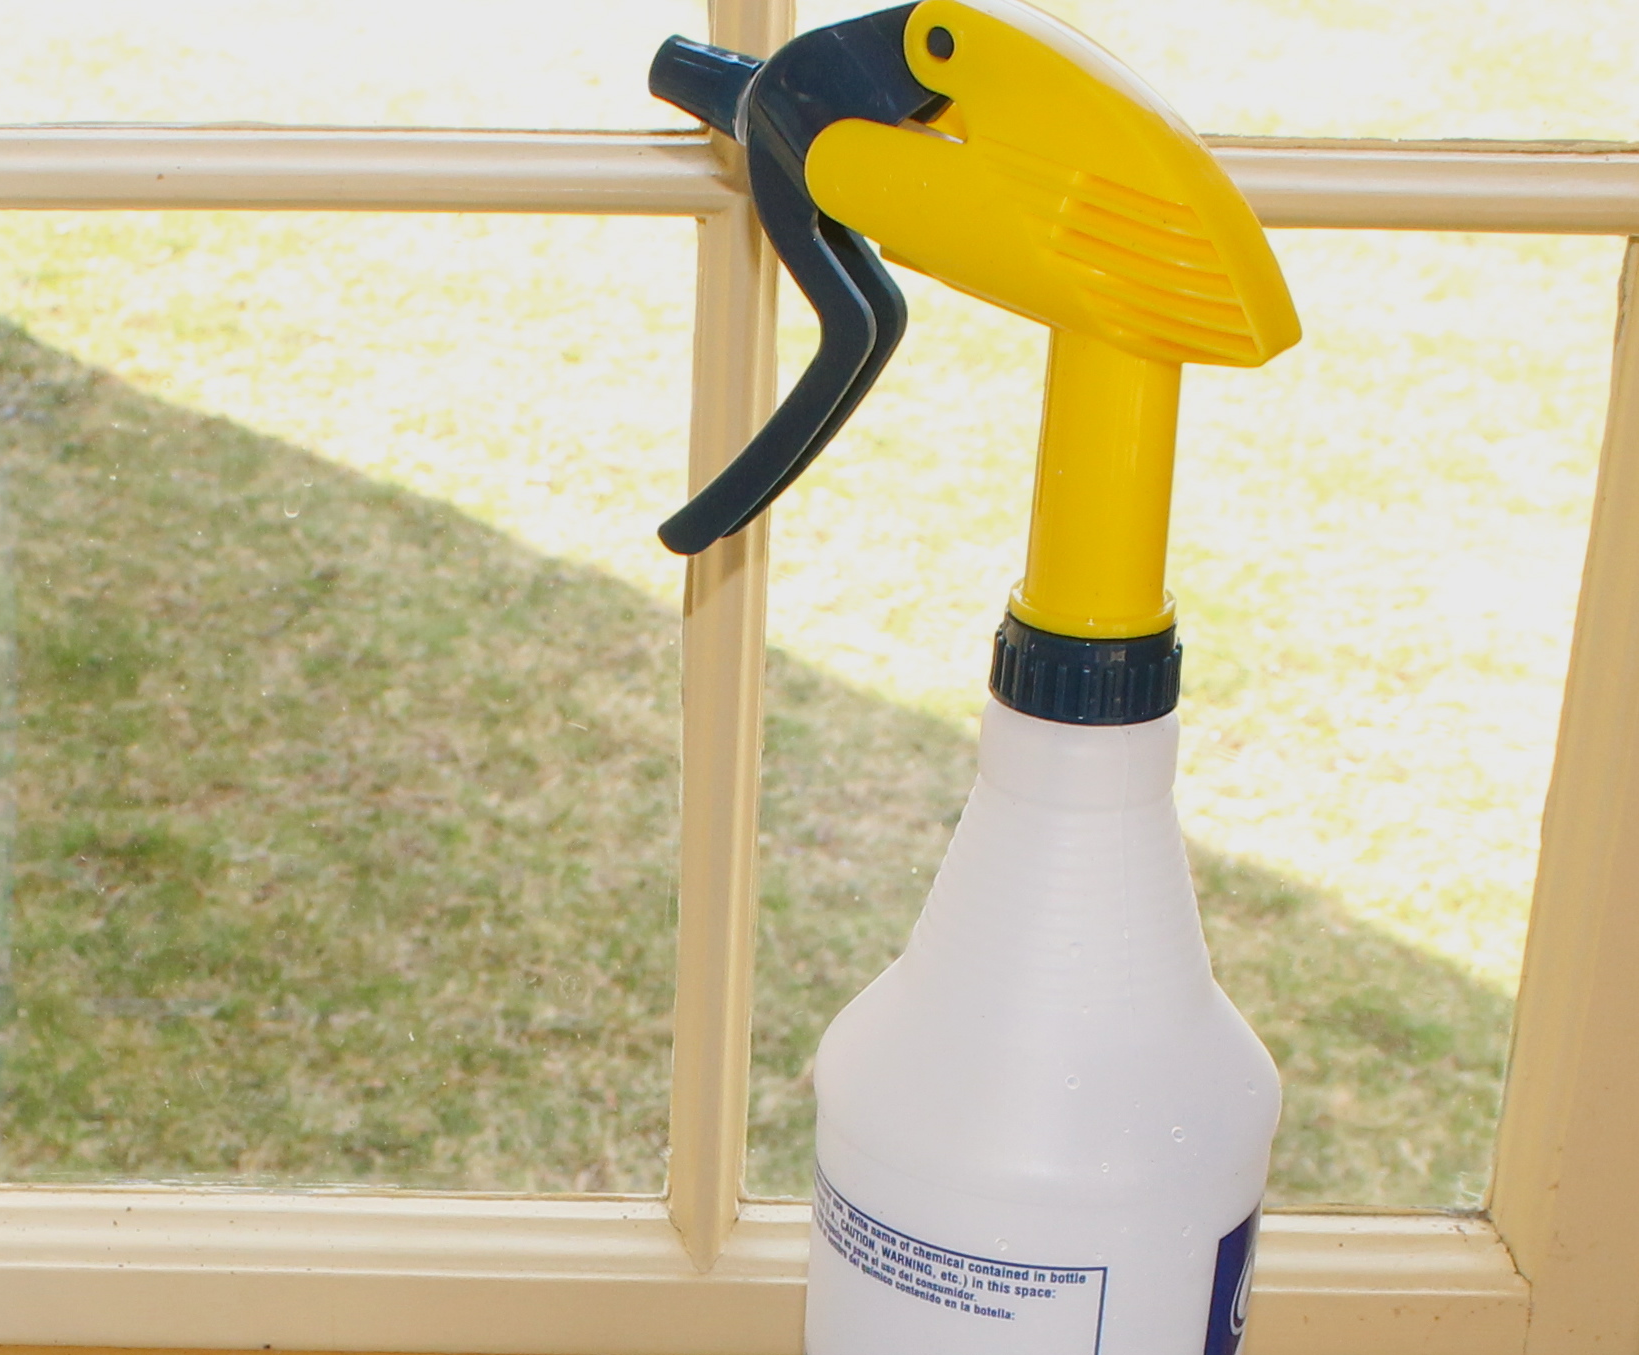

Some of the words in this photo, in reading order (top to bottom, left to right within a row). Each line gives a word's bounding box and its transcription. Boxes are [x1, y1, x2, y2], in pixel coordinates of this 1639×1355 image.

[912, 1245, 964, 1270] chemical
[968, 1261, 1029, 1282] contained
[1033, 1271, 1045, 1282] in
[1050, 1272, 1086, 1284] bottle
[972, 1277, 983, 1289] in
[987, 1279, 1010, 1294] this
[1014, 1285, 1056, 1299] space:
